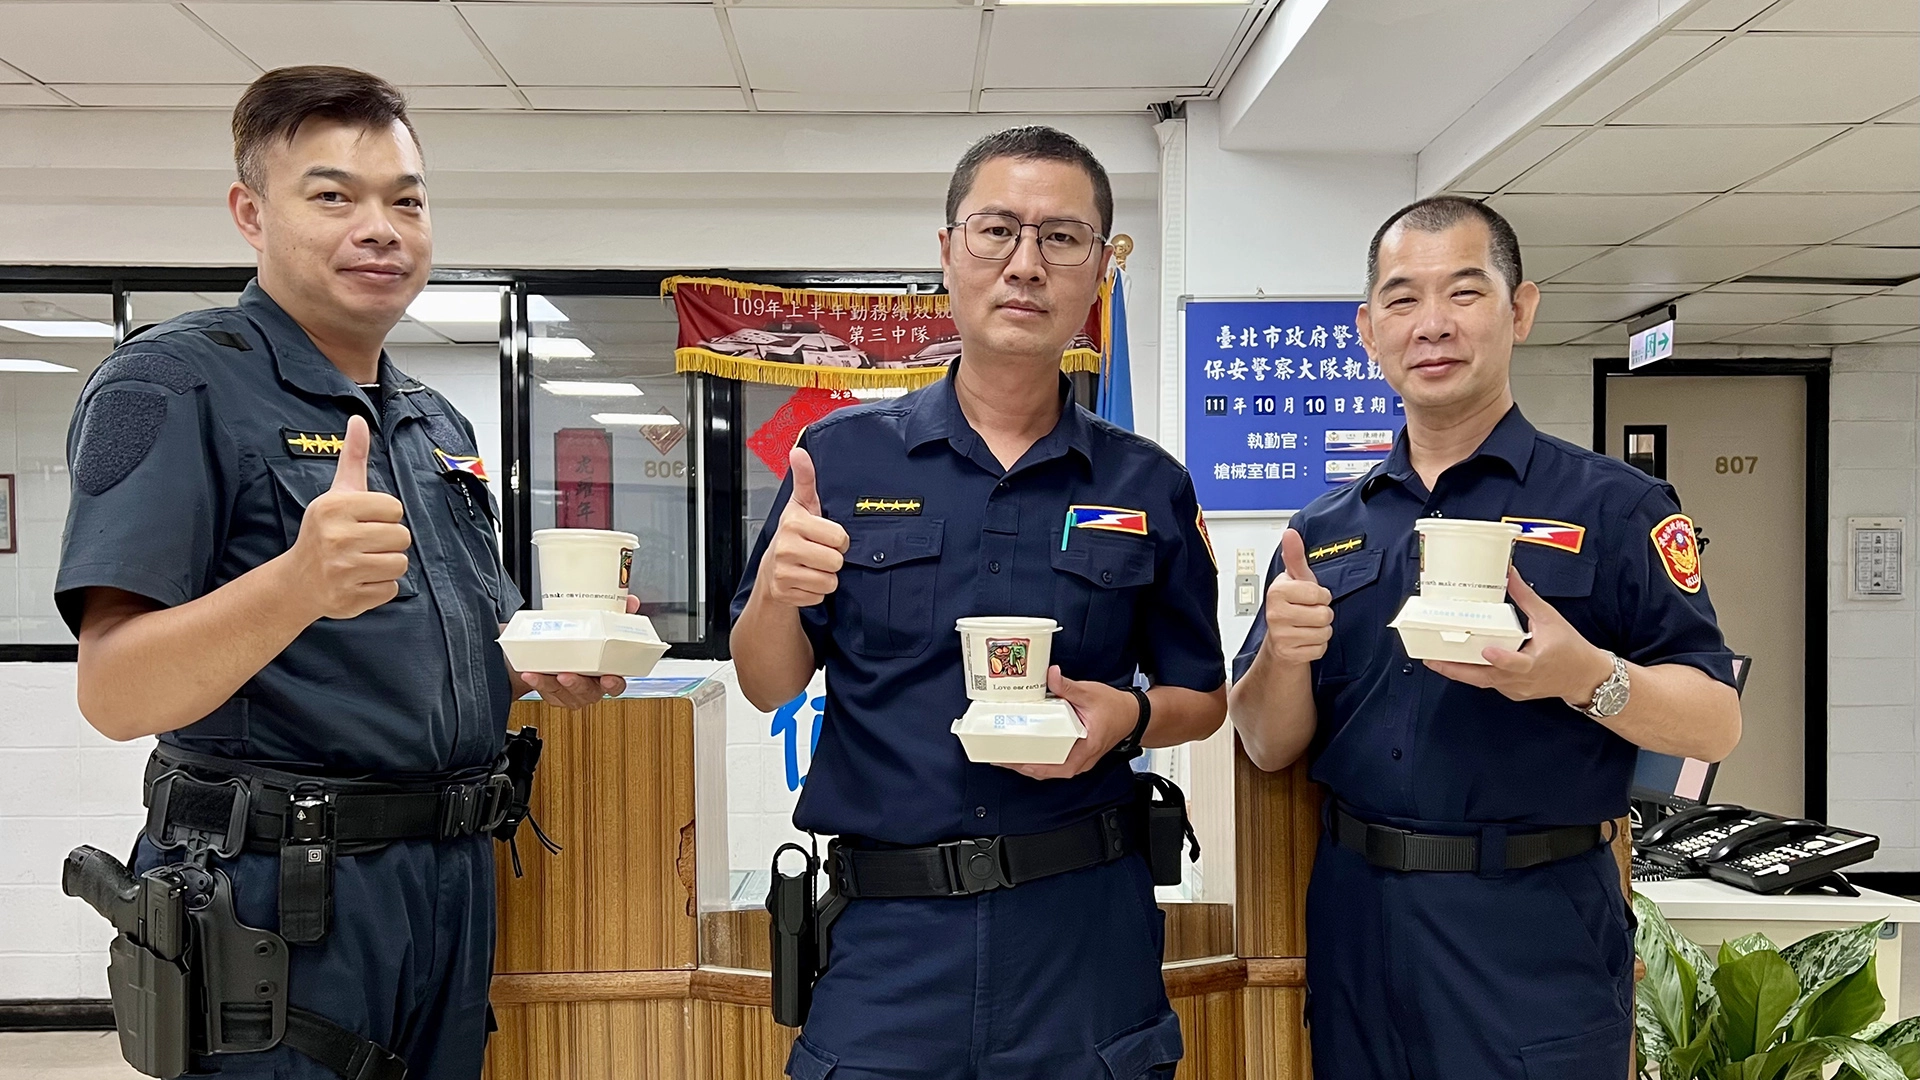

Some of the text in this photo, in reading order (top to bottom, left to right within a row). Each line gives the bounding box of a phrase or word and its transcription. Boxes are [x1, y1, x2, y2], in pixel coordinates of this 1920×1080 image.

[849, 325, 931, 345] 第三中隊
[644, 460, 686, 479] 806
[1715, 456, 1759, 474] 807
